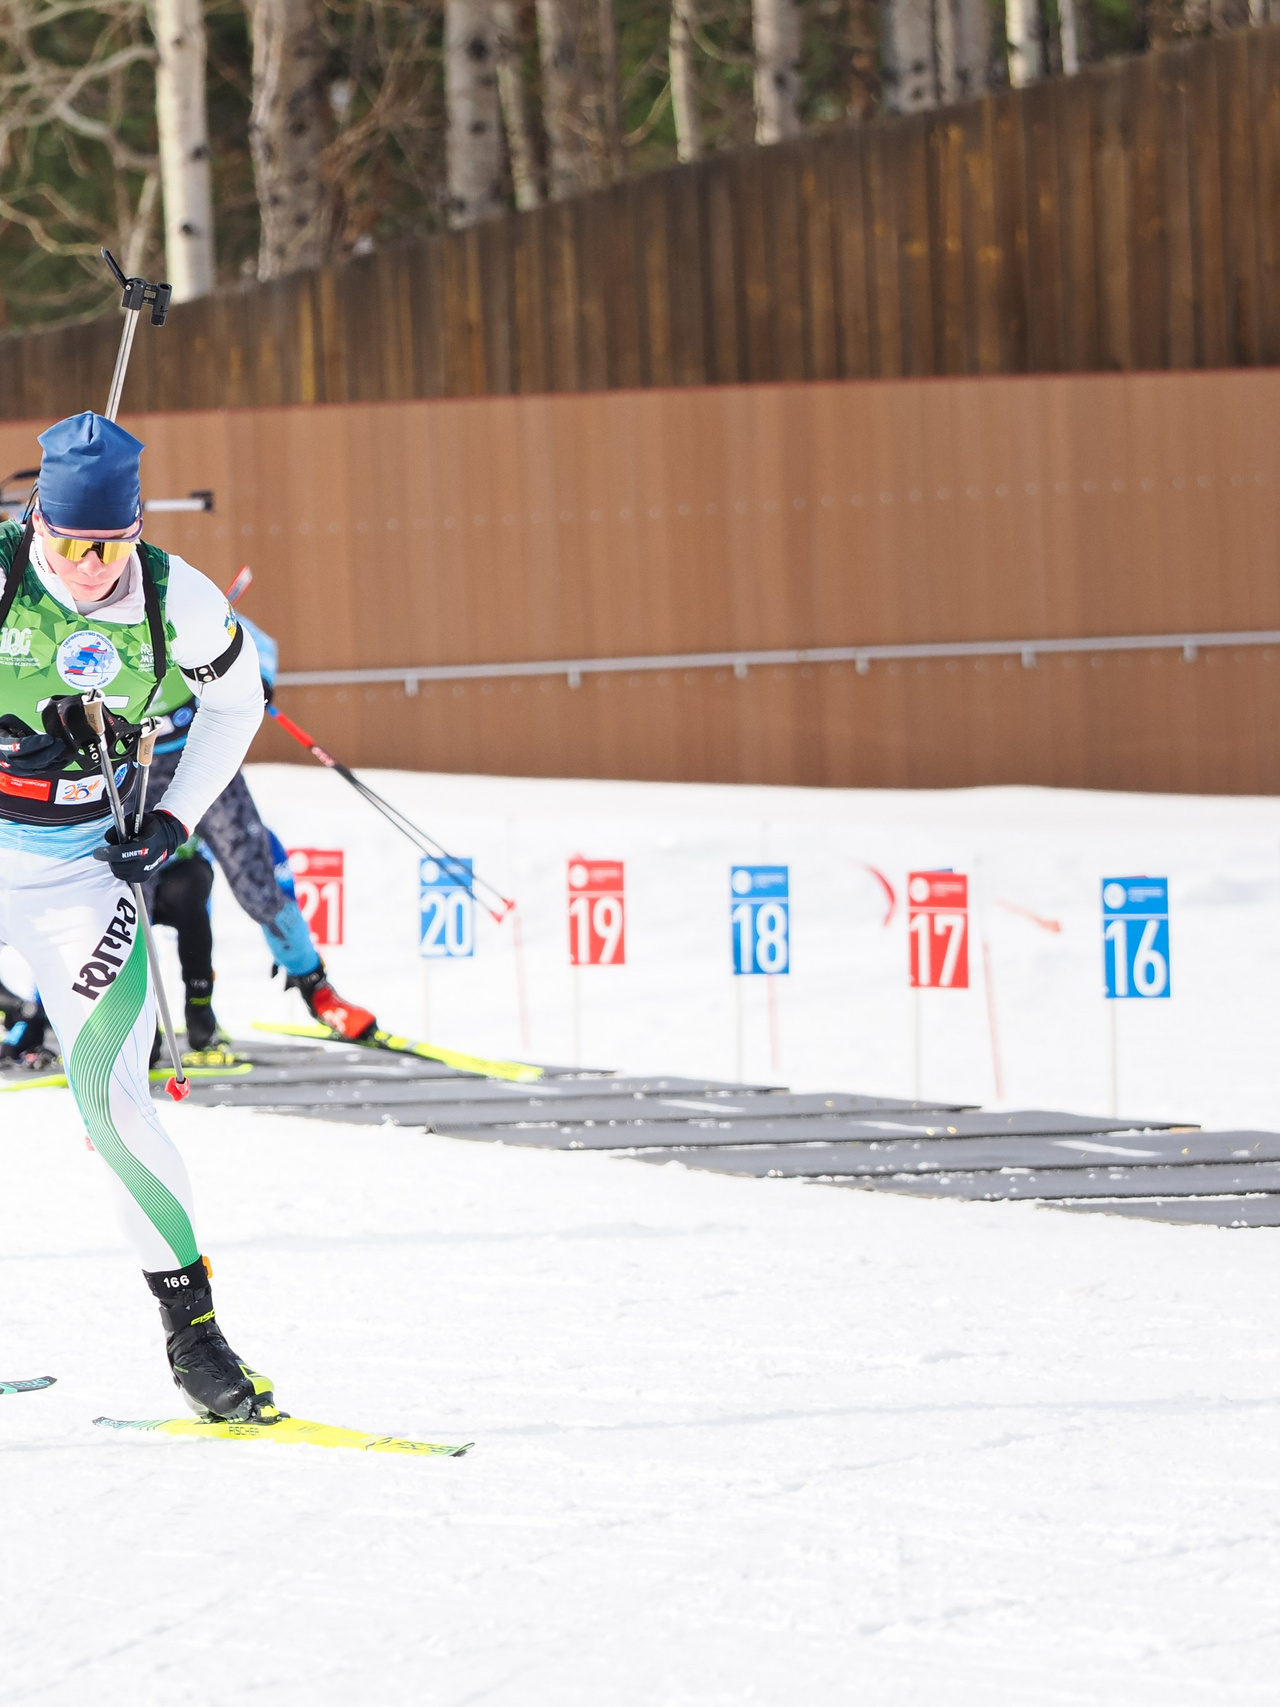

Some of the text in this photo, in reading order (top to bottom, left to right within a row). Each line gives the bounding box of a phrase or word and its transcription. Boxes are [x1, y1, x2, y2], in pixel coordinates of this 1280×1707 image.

[121, 847, 150, 859] KINETIX
[295, 880, 341, 945] 21
[421, 890, 472, 956] 20
[569, 896, 622, 964] 19
[732, 902, 788, 974] 18
[909, 912, 967, 987] 17
[1104, 918, 1167, 997] 16
[163, 1275, 190, 1288] 166
[190, 1309, 216, 1326] FISC
[228, 1426, 260, 1436] FISCHER
